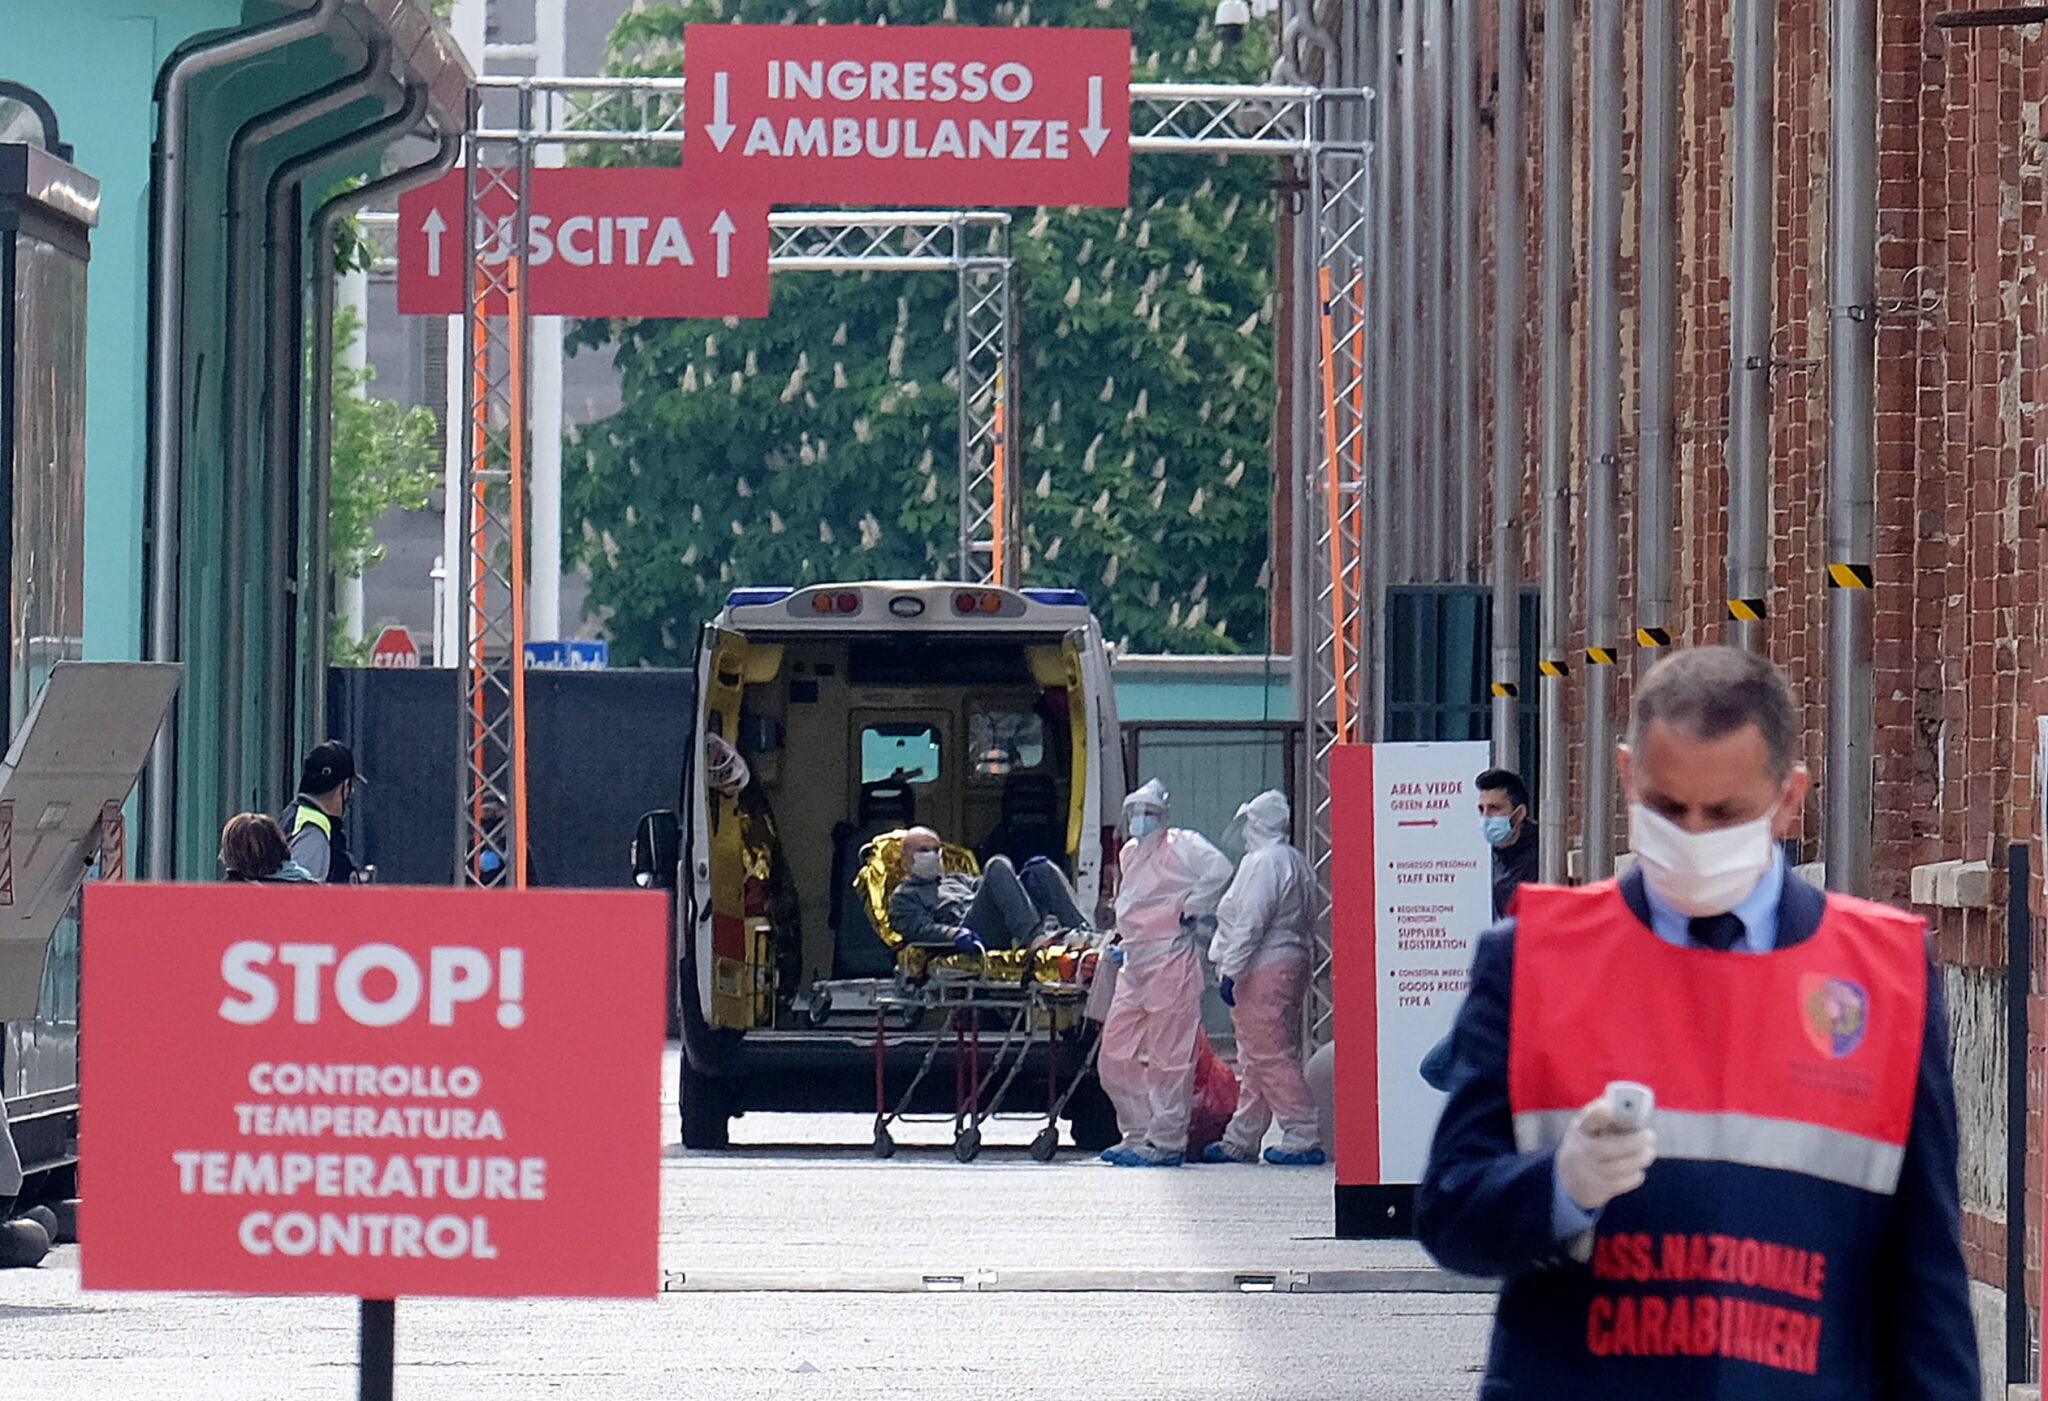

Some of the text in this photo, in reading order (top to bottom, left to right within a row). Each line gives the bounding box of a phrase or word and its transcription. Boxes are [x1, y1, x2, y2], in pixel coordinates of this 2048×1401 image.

[768, 60, 1033, 102] INGRESSO
[743, 117, 1069, 159] AMBULANZE
[474, 214, 694, 266] USCITA
[1390, 781, 1462, 795] AREA VERDE
[1391, 799, 1450, 811] GREEN AREA
[1397, 873, 1456, 884] STAFF ENTRY
[1398, 927, 1447, 939] SUPPLIERS
[1398, 939, 1467, 951] REGISTRATION
[219, 940, 525, 1029] STOP!
[1398, 980, 1435, 992] GOODS
[1398, 996, 1432, 1008] TYPE A
[248, 1062, 481, 1098] CONTROLLO
[234, 1104, 505, 1140] TEMPERATURA
[172, 1151, 546, 1200] TEMPERATURE
[238, 1211, 498, 1259] CONTROL
[1587, 1295, 1822, 1375] CARABINIERI
